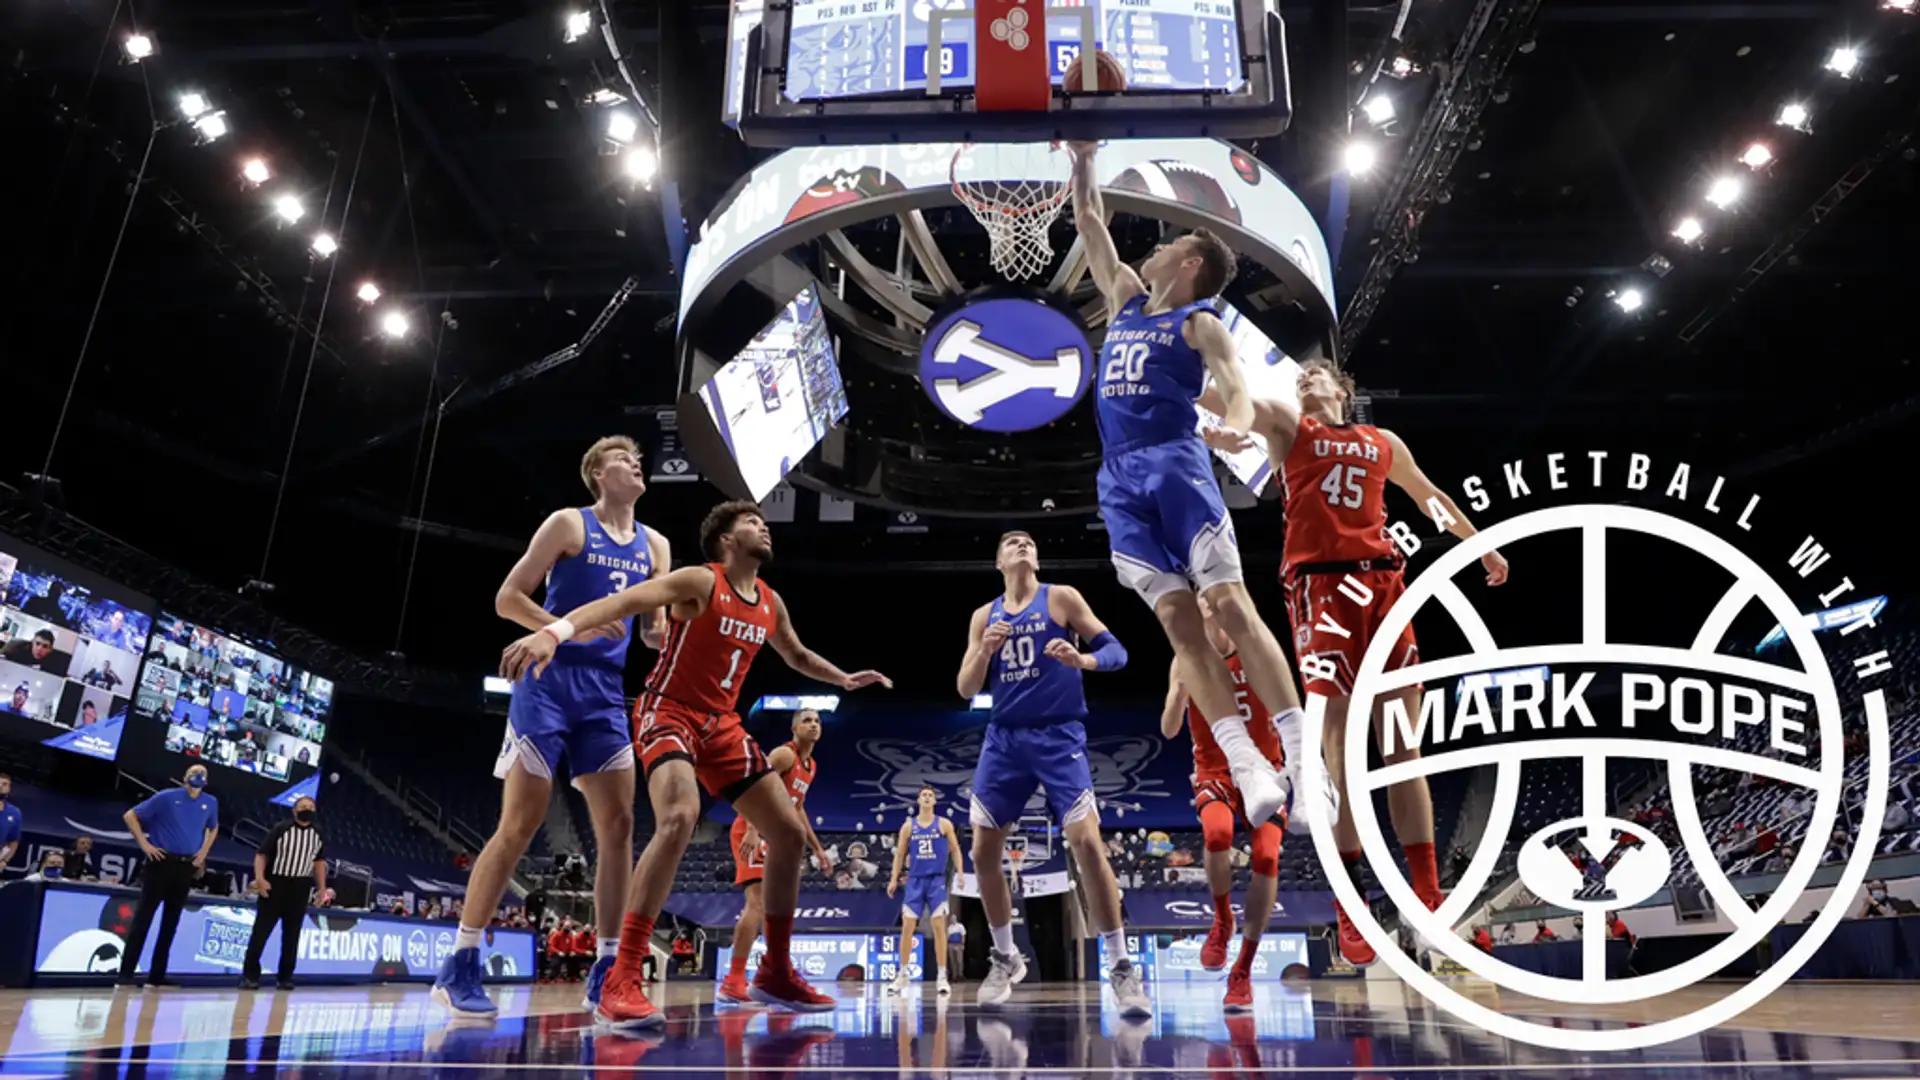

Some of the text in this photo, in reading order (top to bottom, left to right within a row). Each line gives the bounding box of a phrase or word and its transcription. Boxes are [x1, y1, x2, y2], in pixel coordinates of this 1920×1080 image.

[1104, 342, 1151, 382] 20
[1101, 382, 1151, 399] YOUNG
[1313, 439, 1379, 464] UTAH
[1320, 463, 1368, 510] 45
[586, 552, 650, 576] BRIGHAM
[608, 570, 628, 597] 3
[718, 615, 767, 646] UTAH
[1000, 635, 1035, 669] 40
[720, 648, 743, 690] 1
[1000, 667, 1040, 684] YOUNG
[918, 839, 934, 854] 21
[298, 928, 378, 960] WEEKDAYS
[383, 934, 402, 961] ON
[790, 940, 857, 953] EEKDAYS ON
[882, 935, 894, 951] 51
[1279, 939, 1297, 952] ON
[881, 963, 896, 979] 69
